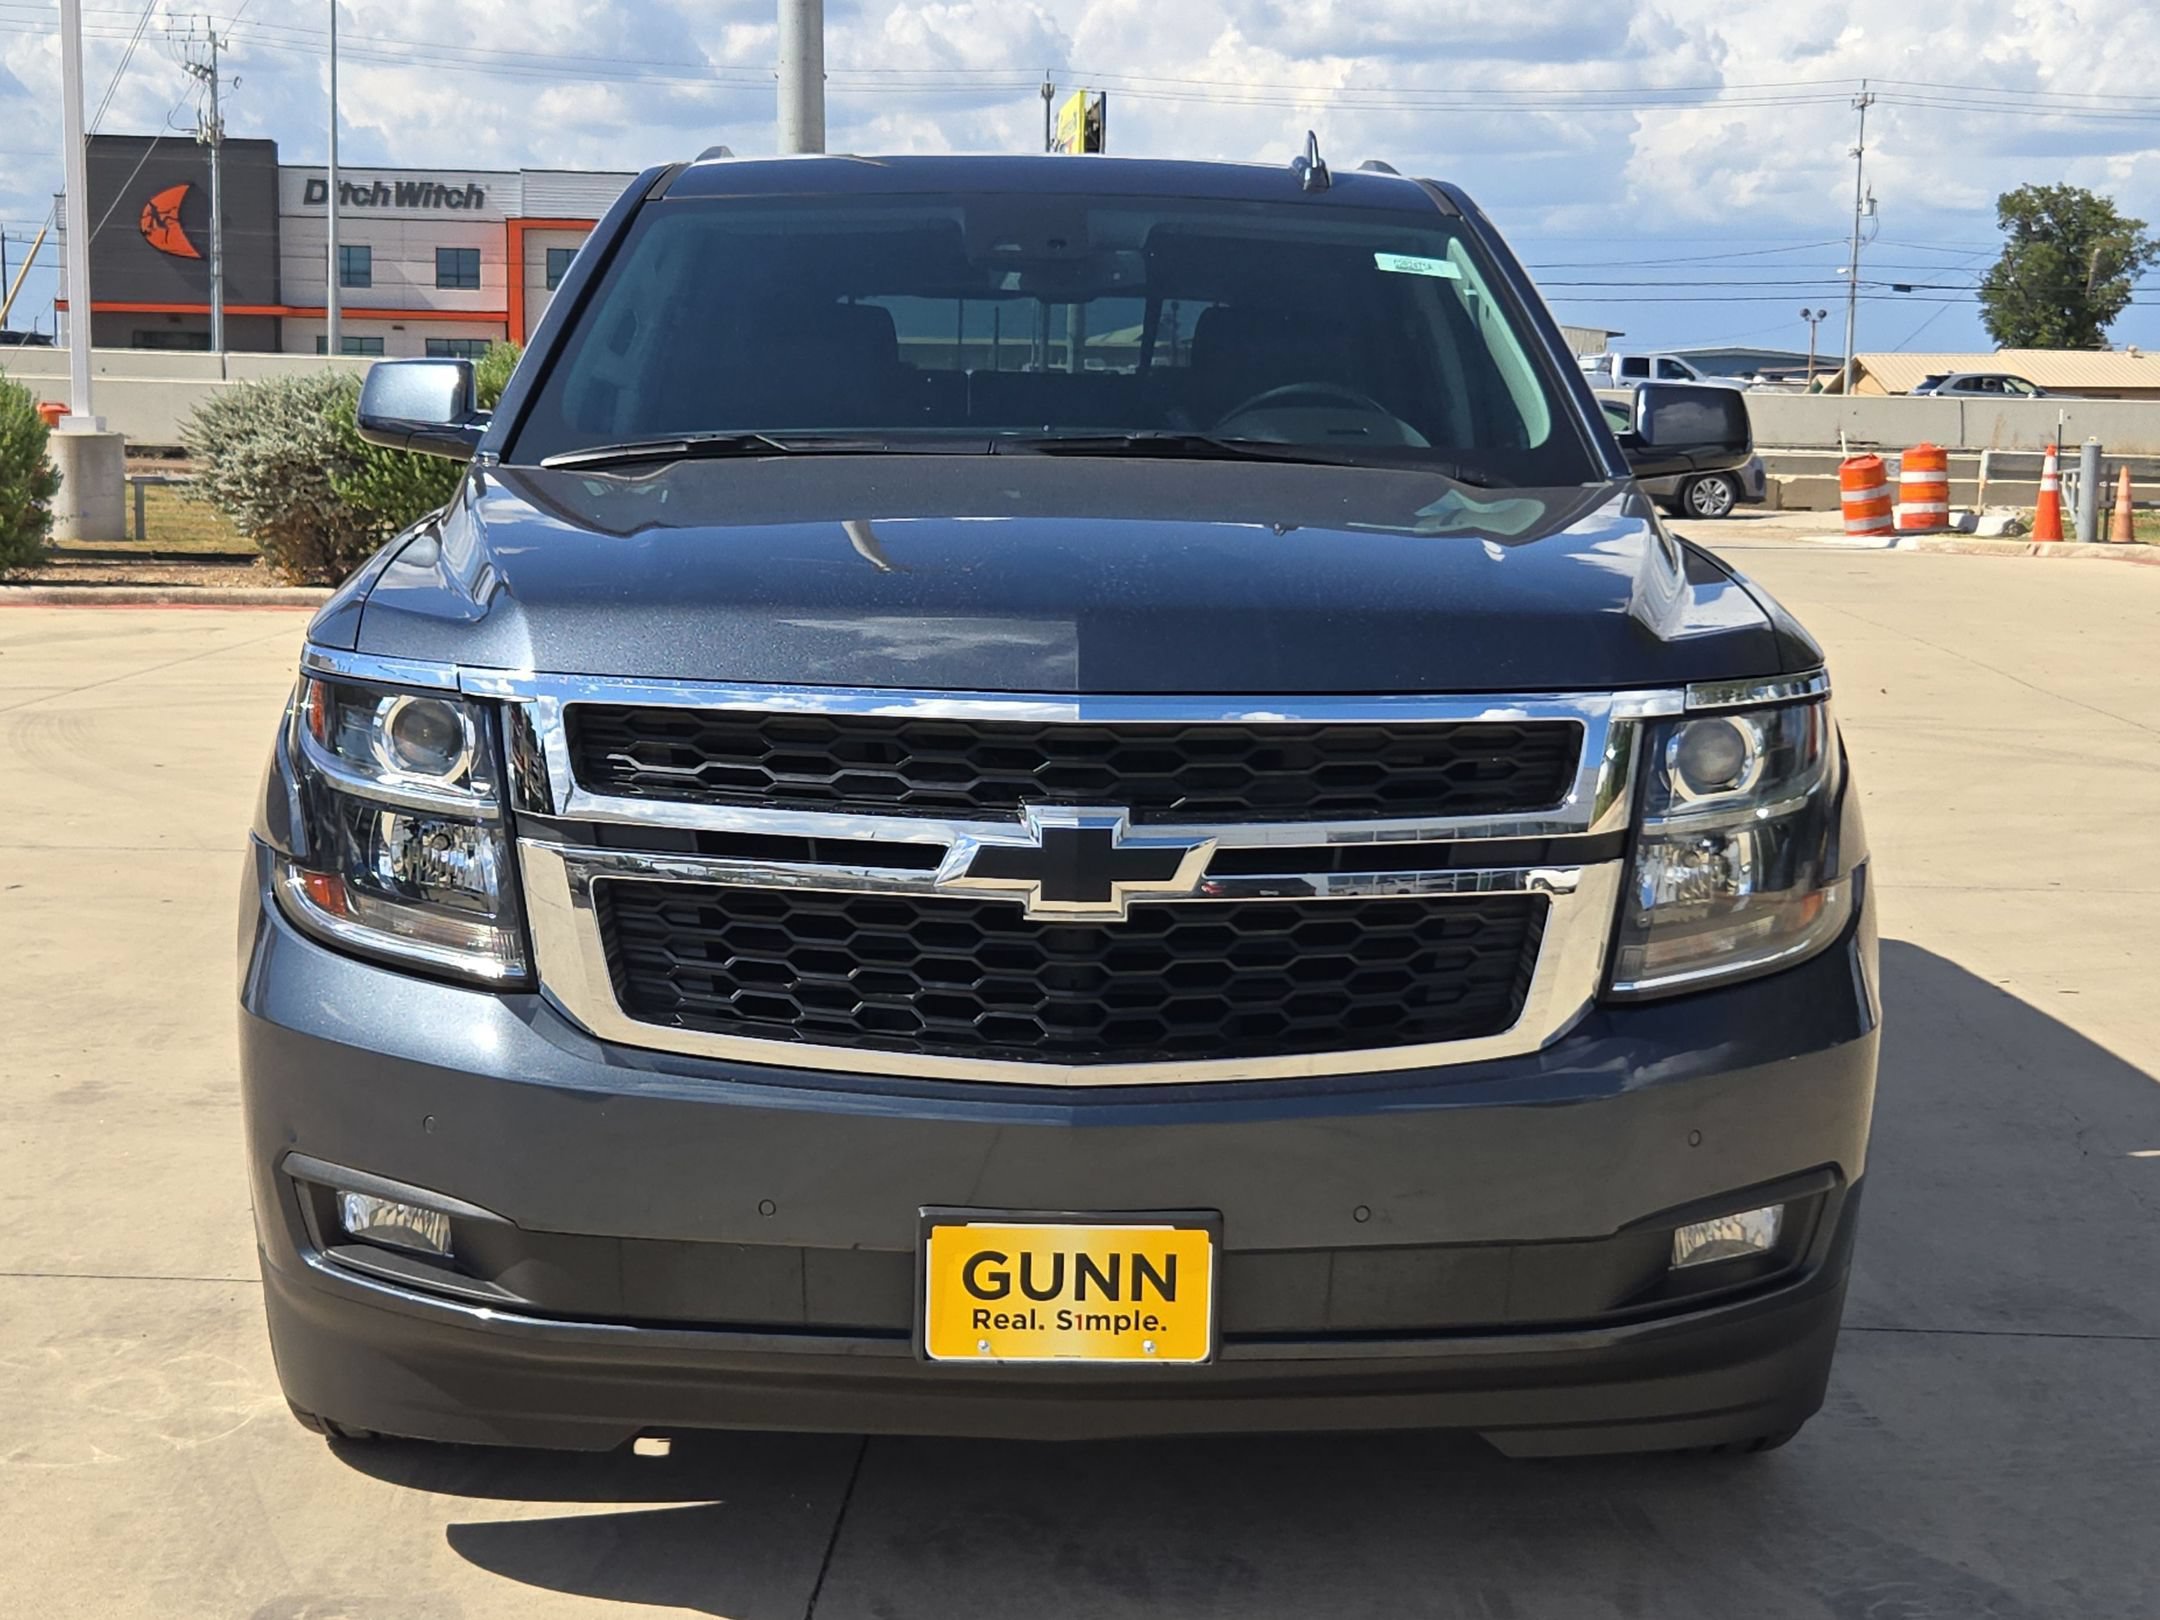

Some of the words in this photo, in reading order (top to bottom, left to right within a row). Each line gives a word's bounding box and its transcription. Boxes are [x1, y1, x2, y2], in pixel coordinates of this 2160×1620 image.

[303, 178, 391, 207] Dtch
[395, 181, 485, 209] Witch
[962, 1250, 1177, 1301] GUNN
[972, 1308, 1045, 1330] Real.
